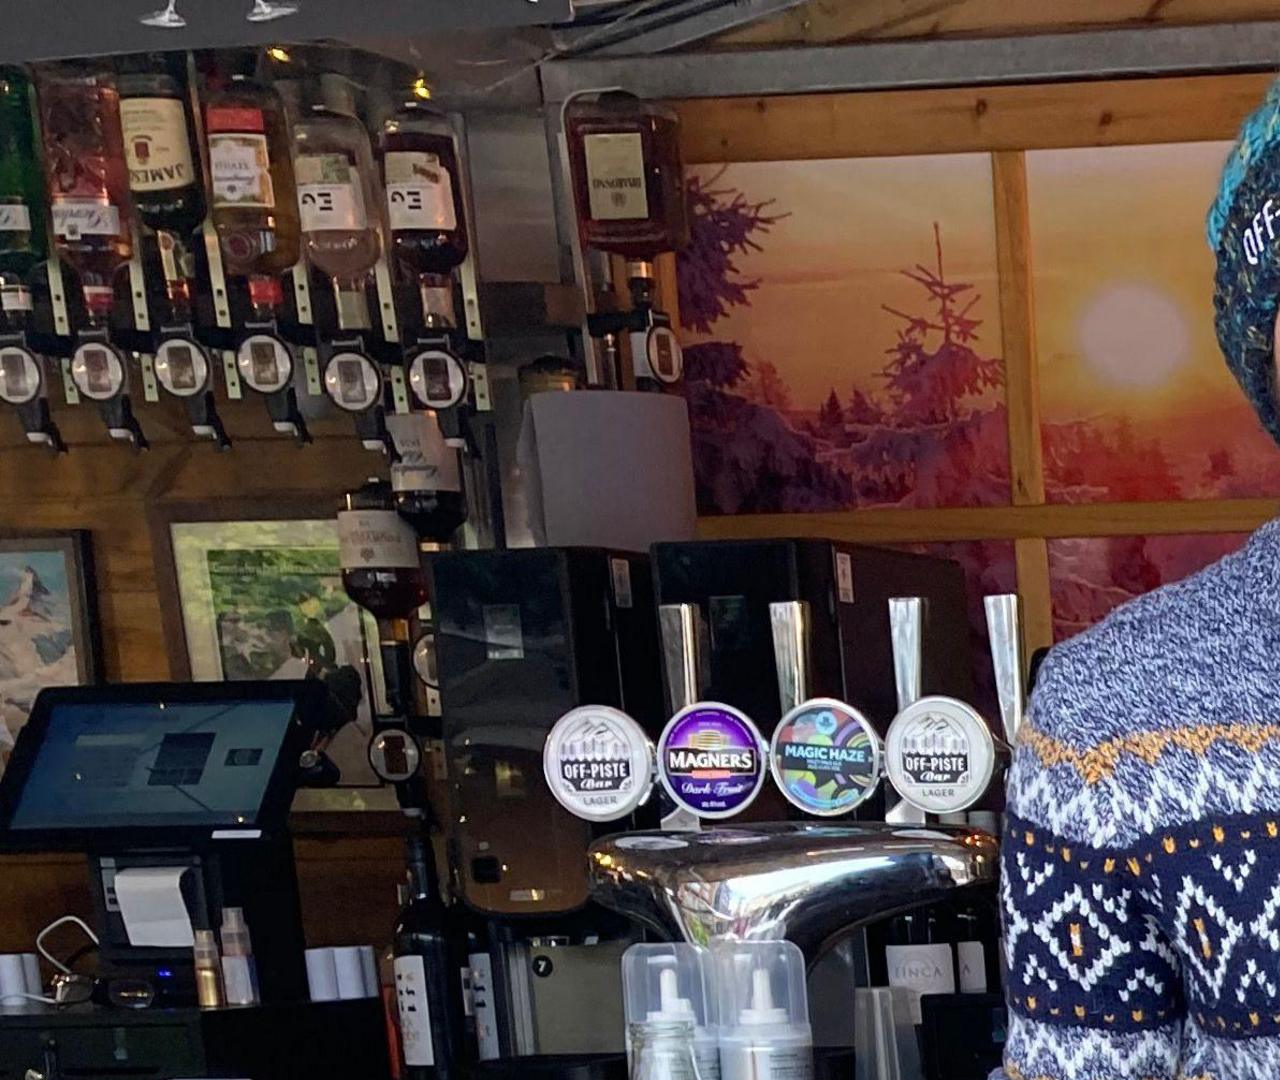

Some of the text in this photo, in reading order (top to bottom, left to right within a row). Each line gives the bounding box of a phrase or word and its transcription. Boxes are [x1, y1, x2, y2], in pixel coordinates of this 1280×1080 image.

[669, 751, 753, 769] MAGNERS
[784, 744, 865, 763] MAGIC HAZE
[563, 762, 627, 779] OFF-PISTE
[905, 757, 965, 772] OFF-PISTE
[920, 770, 951, 782] Bar
[580, 778, 613, 790] Bar
[681, 782, 711, 795] Dark
[921, 788, 955, 797] LAGER
[583, 796, 618, 805] LAGER
